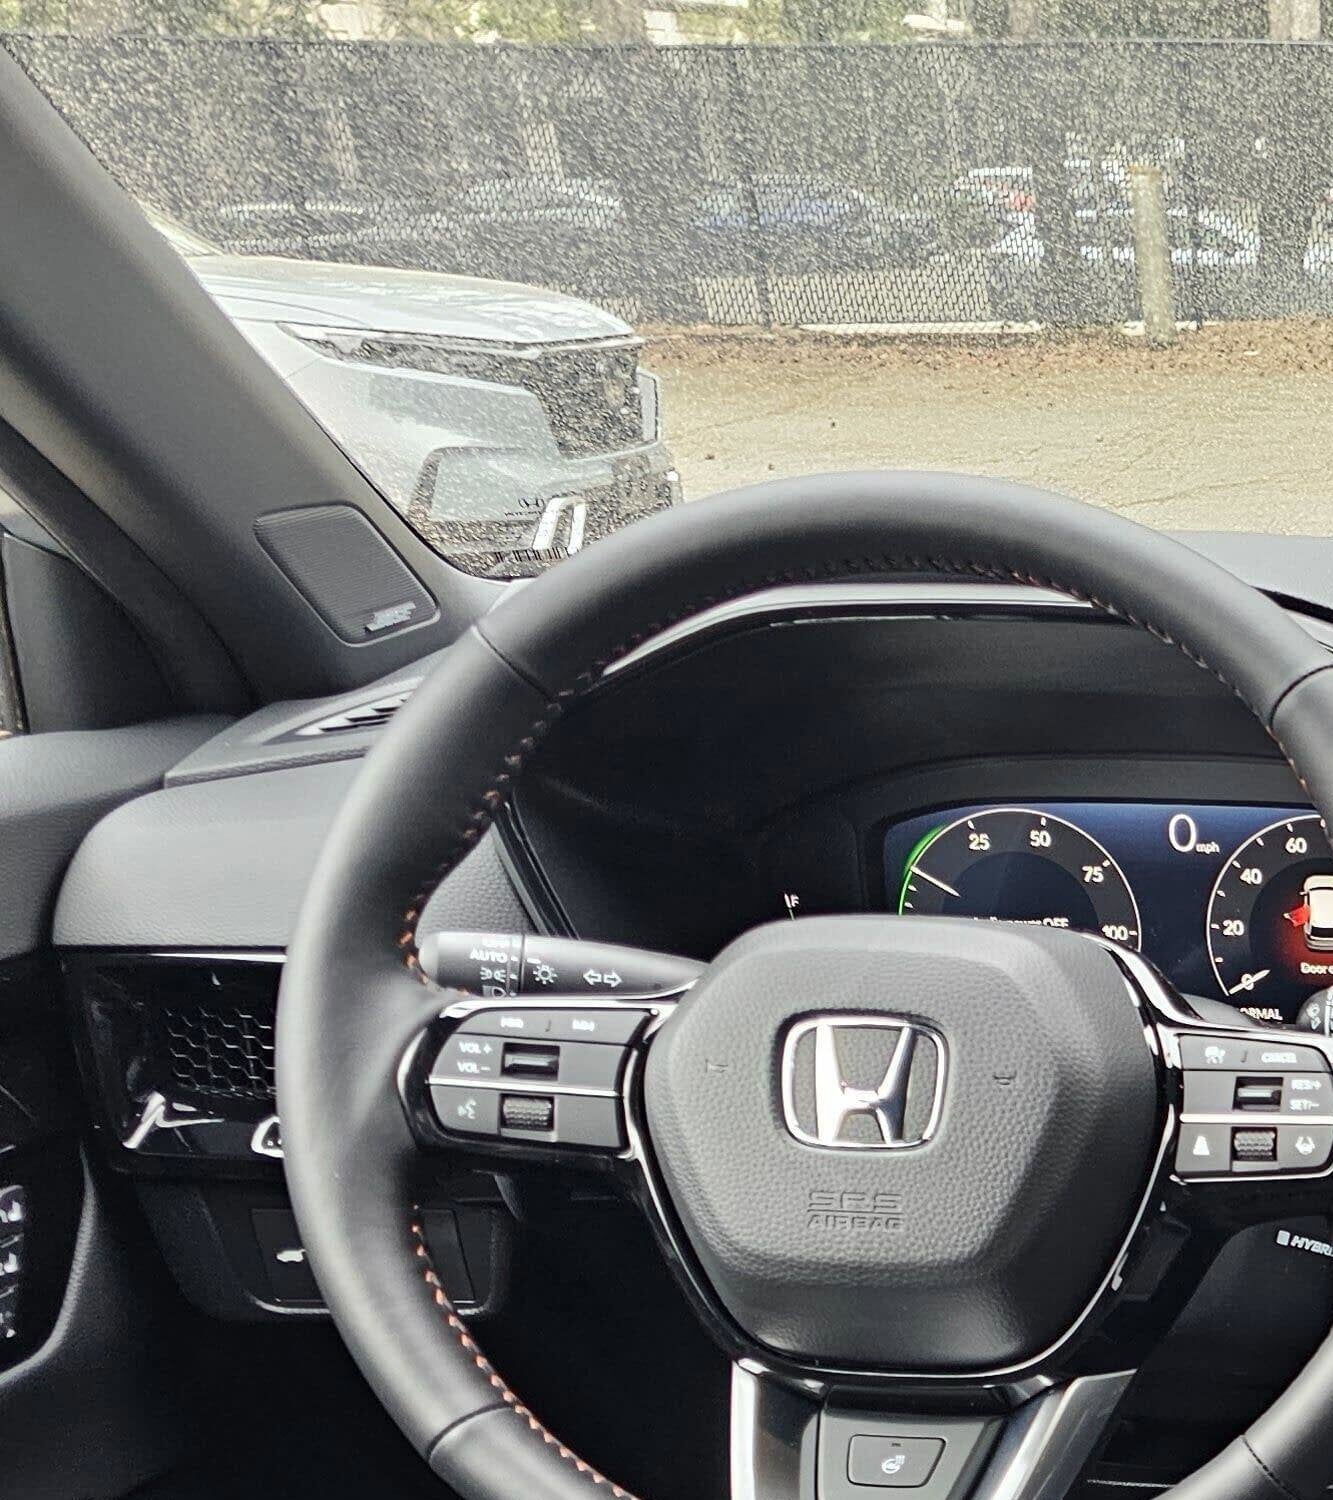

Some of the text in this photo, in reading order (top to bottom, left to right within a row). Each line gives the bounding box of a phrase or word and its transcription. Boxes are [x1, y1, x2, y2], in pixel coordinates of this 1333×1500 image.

[968, 833, 991, 851] 25
[1030, 830, 1051, 848] 50
[1168, 814, 1220, 854] 0 mph
[1285, 838, 1308, 854] 60
[1083, 866, 1104, 883] 75
[1240, 868, 1263, 886] 40
[1102, 925, 1128, 941] 100
[1222, 920, 1245, 936] 20
[470, 948, 507, 963] AUTO
[1300, 962, 1328, 974] Door
[1240, 1007, 1283, 1020] RMAL
